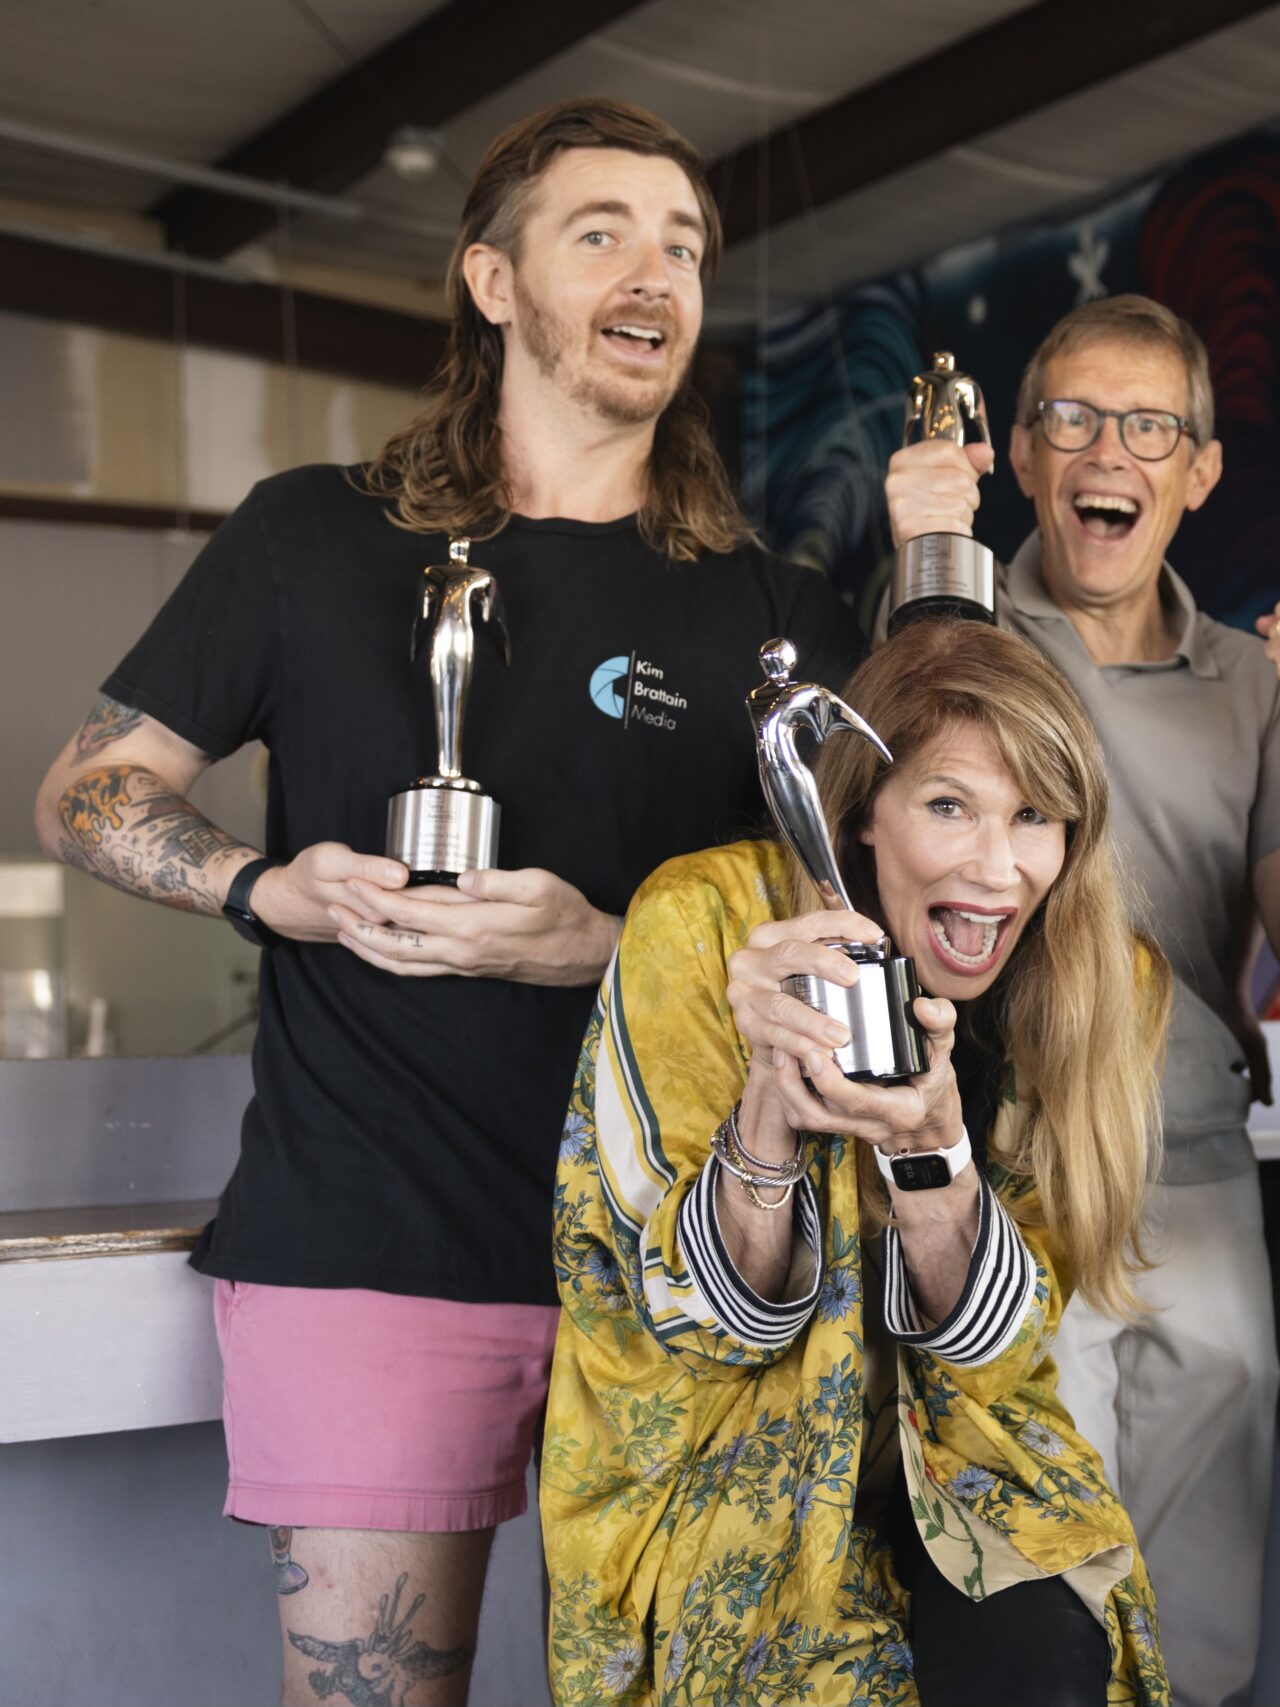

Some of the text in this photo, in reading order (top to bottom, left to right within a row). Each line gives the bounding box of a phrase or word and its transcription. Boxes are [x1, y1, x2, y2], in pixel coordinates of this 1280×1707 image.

[636, 660, 664, 680] Kim
[633, 680, 688, 710] Brattain
[630, 704, 677, 730] Media
